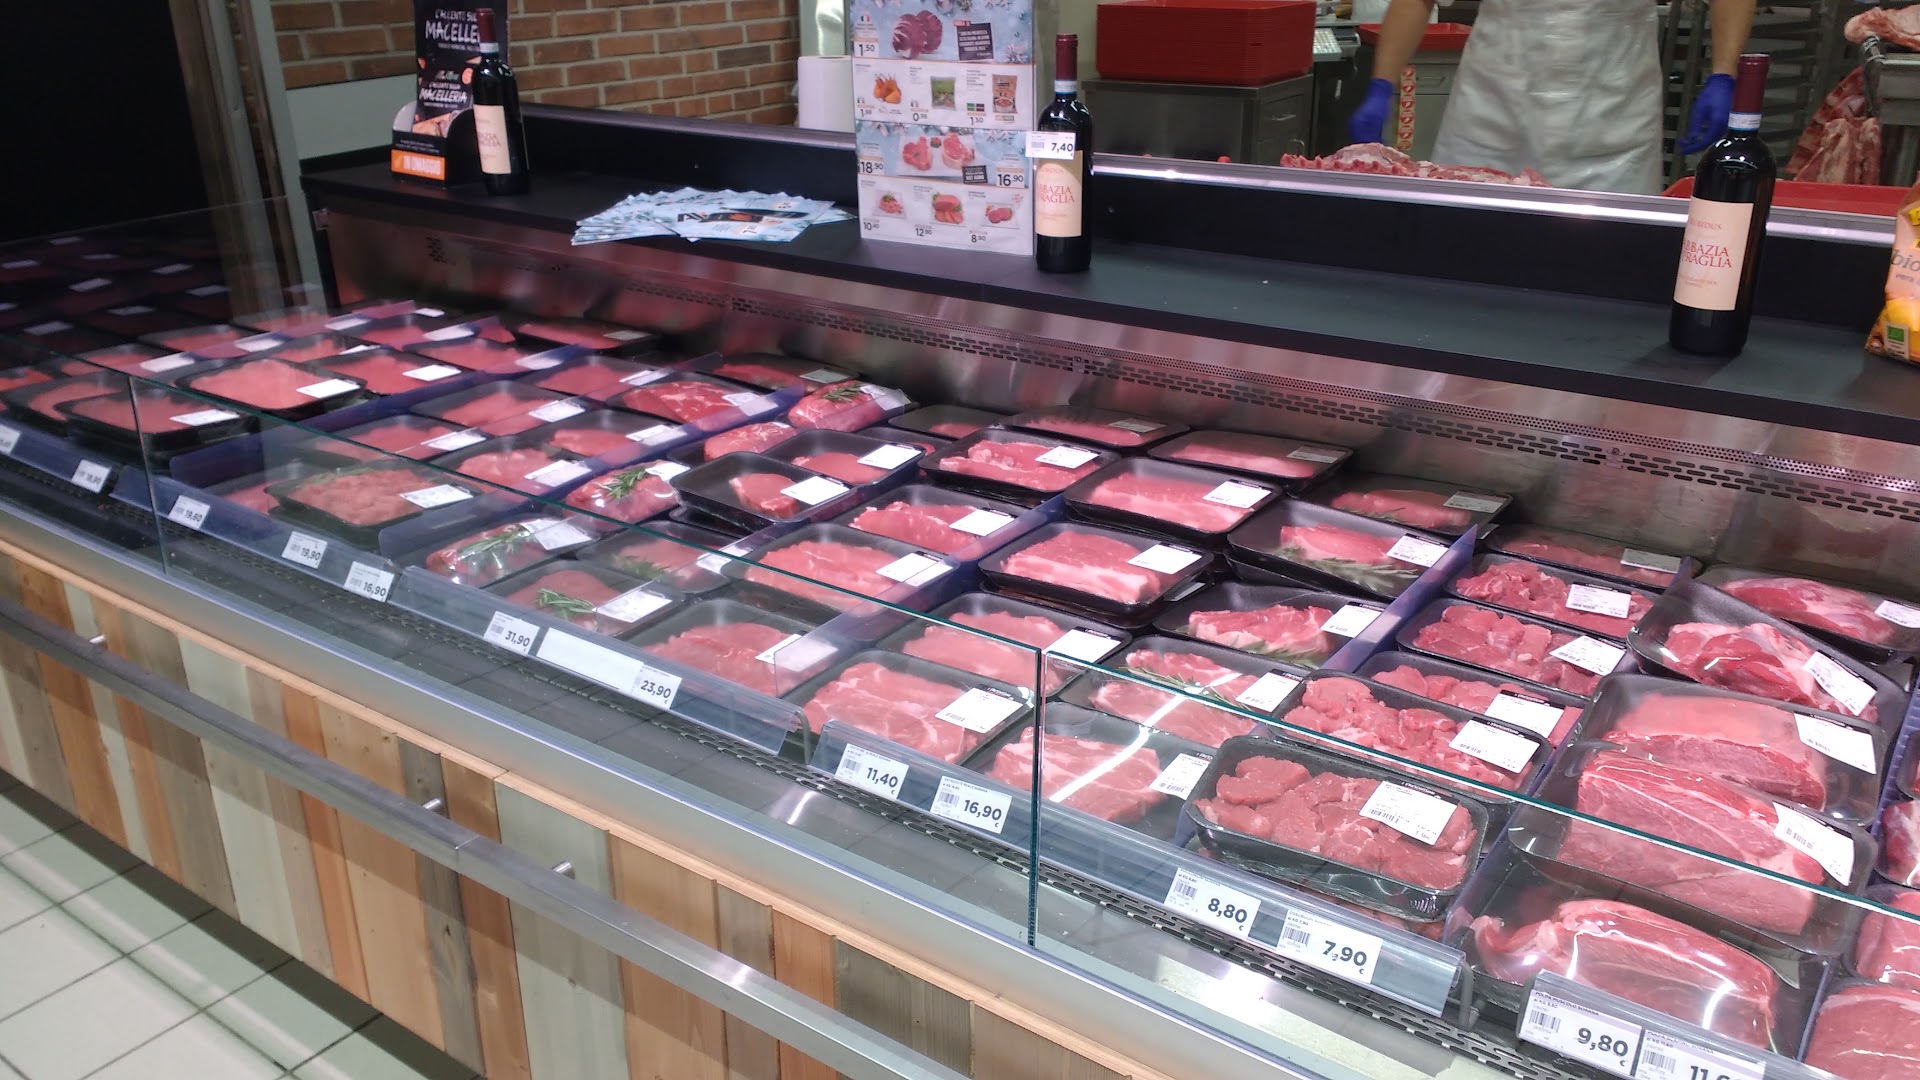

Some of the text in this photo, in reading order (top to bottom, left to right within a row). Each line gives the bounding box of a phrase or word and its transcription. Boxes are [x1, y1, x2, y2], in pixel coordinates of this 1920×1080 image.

[419, 87, 467, 103] MACELLERIA
[1051, 142, 1074, 153] 7,40
[301, 547, 321, 561] 19,90
[363, 582, 387, 597] 16,90
[505, 630, 530, 647] 31,90
[640, 680, 672, 699] 23,90
[867, 767, 898, 788] 11,40
[963, 799, 1002, 821] 16,90
[1208, 897, 1248, 923] 8,80
[1322, 940, 1367, 967] 7,90
[1552, 997, 1577, 1009] MUSCOLO
[1577, 1027, 1629, 1057] 9,80
